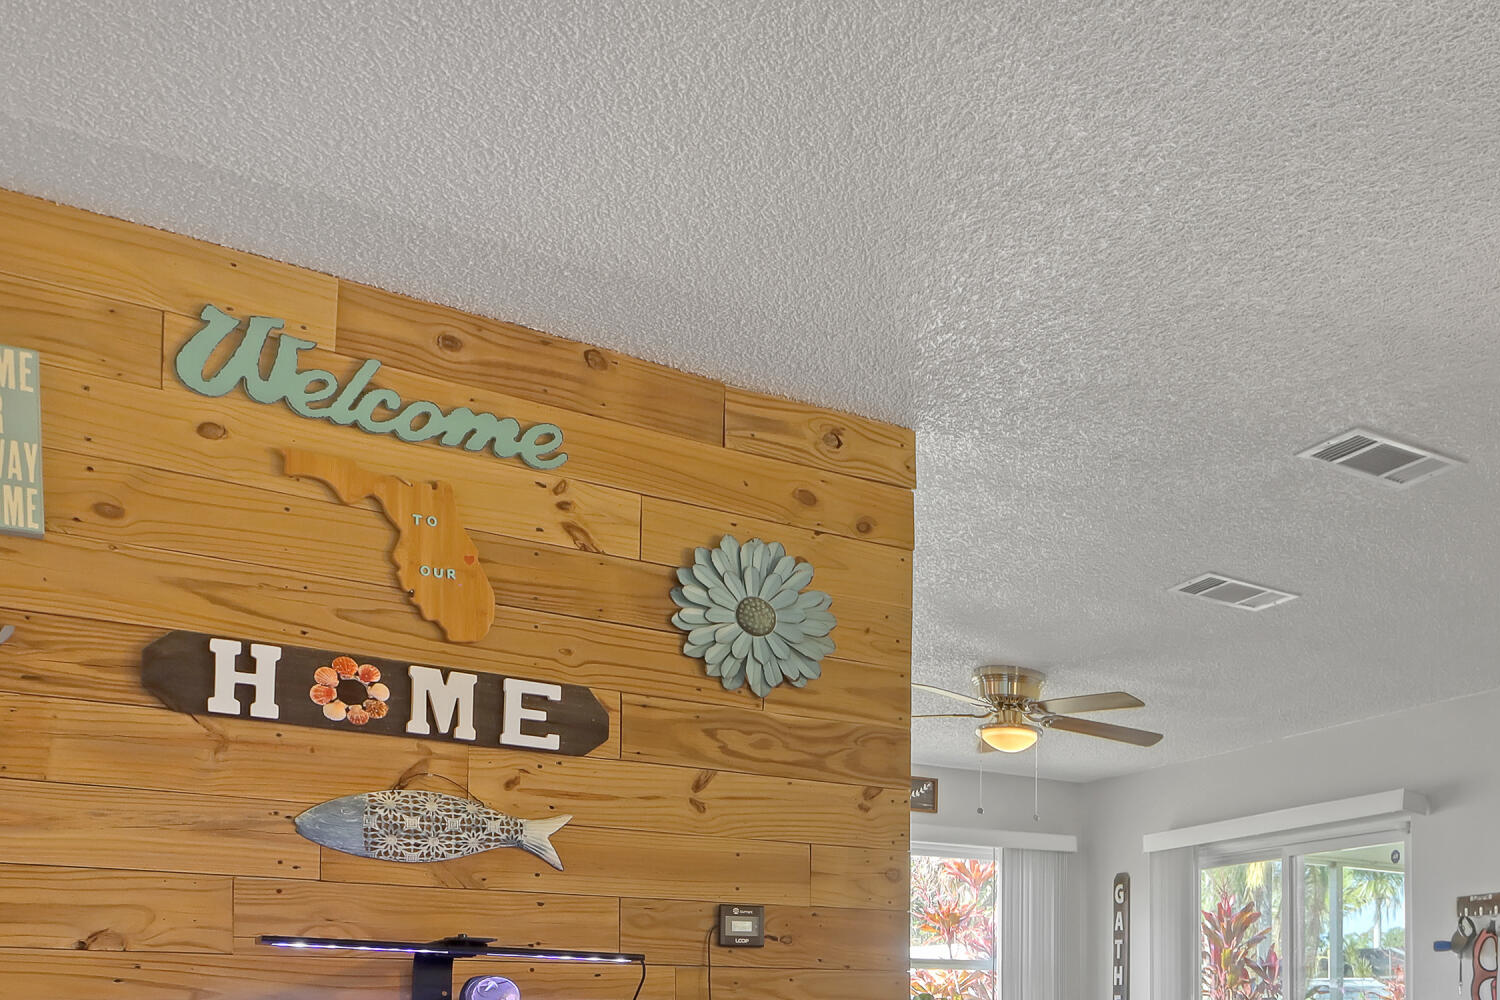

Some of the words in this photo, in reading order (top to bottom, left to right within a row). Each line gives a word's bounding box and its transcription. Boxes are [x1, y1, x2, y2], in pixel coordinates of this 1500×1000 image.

[175, 303, 568, 469] Welcome
[0, 439, 38, 483] AY
[412, 513, 438, 527] TO
[420, 565, 456, 580] OUR
[207, 638, 562, 750] HOME
